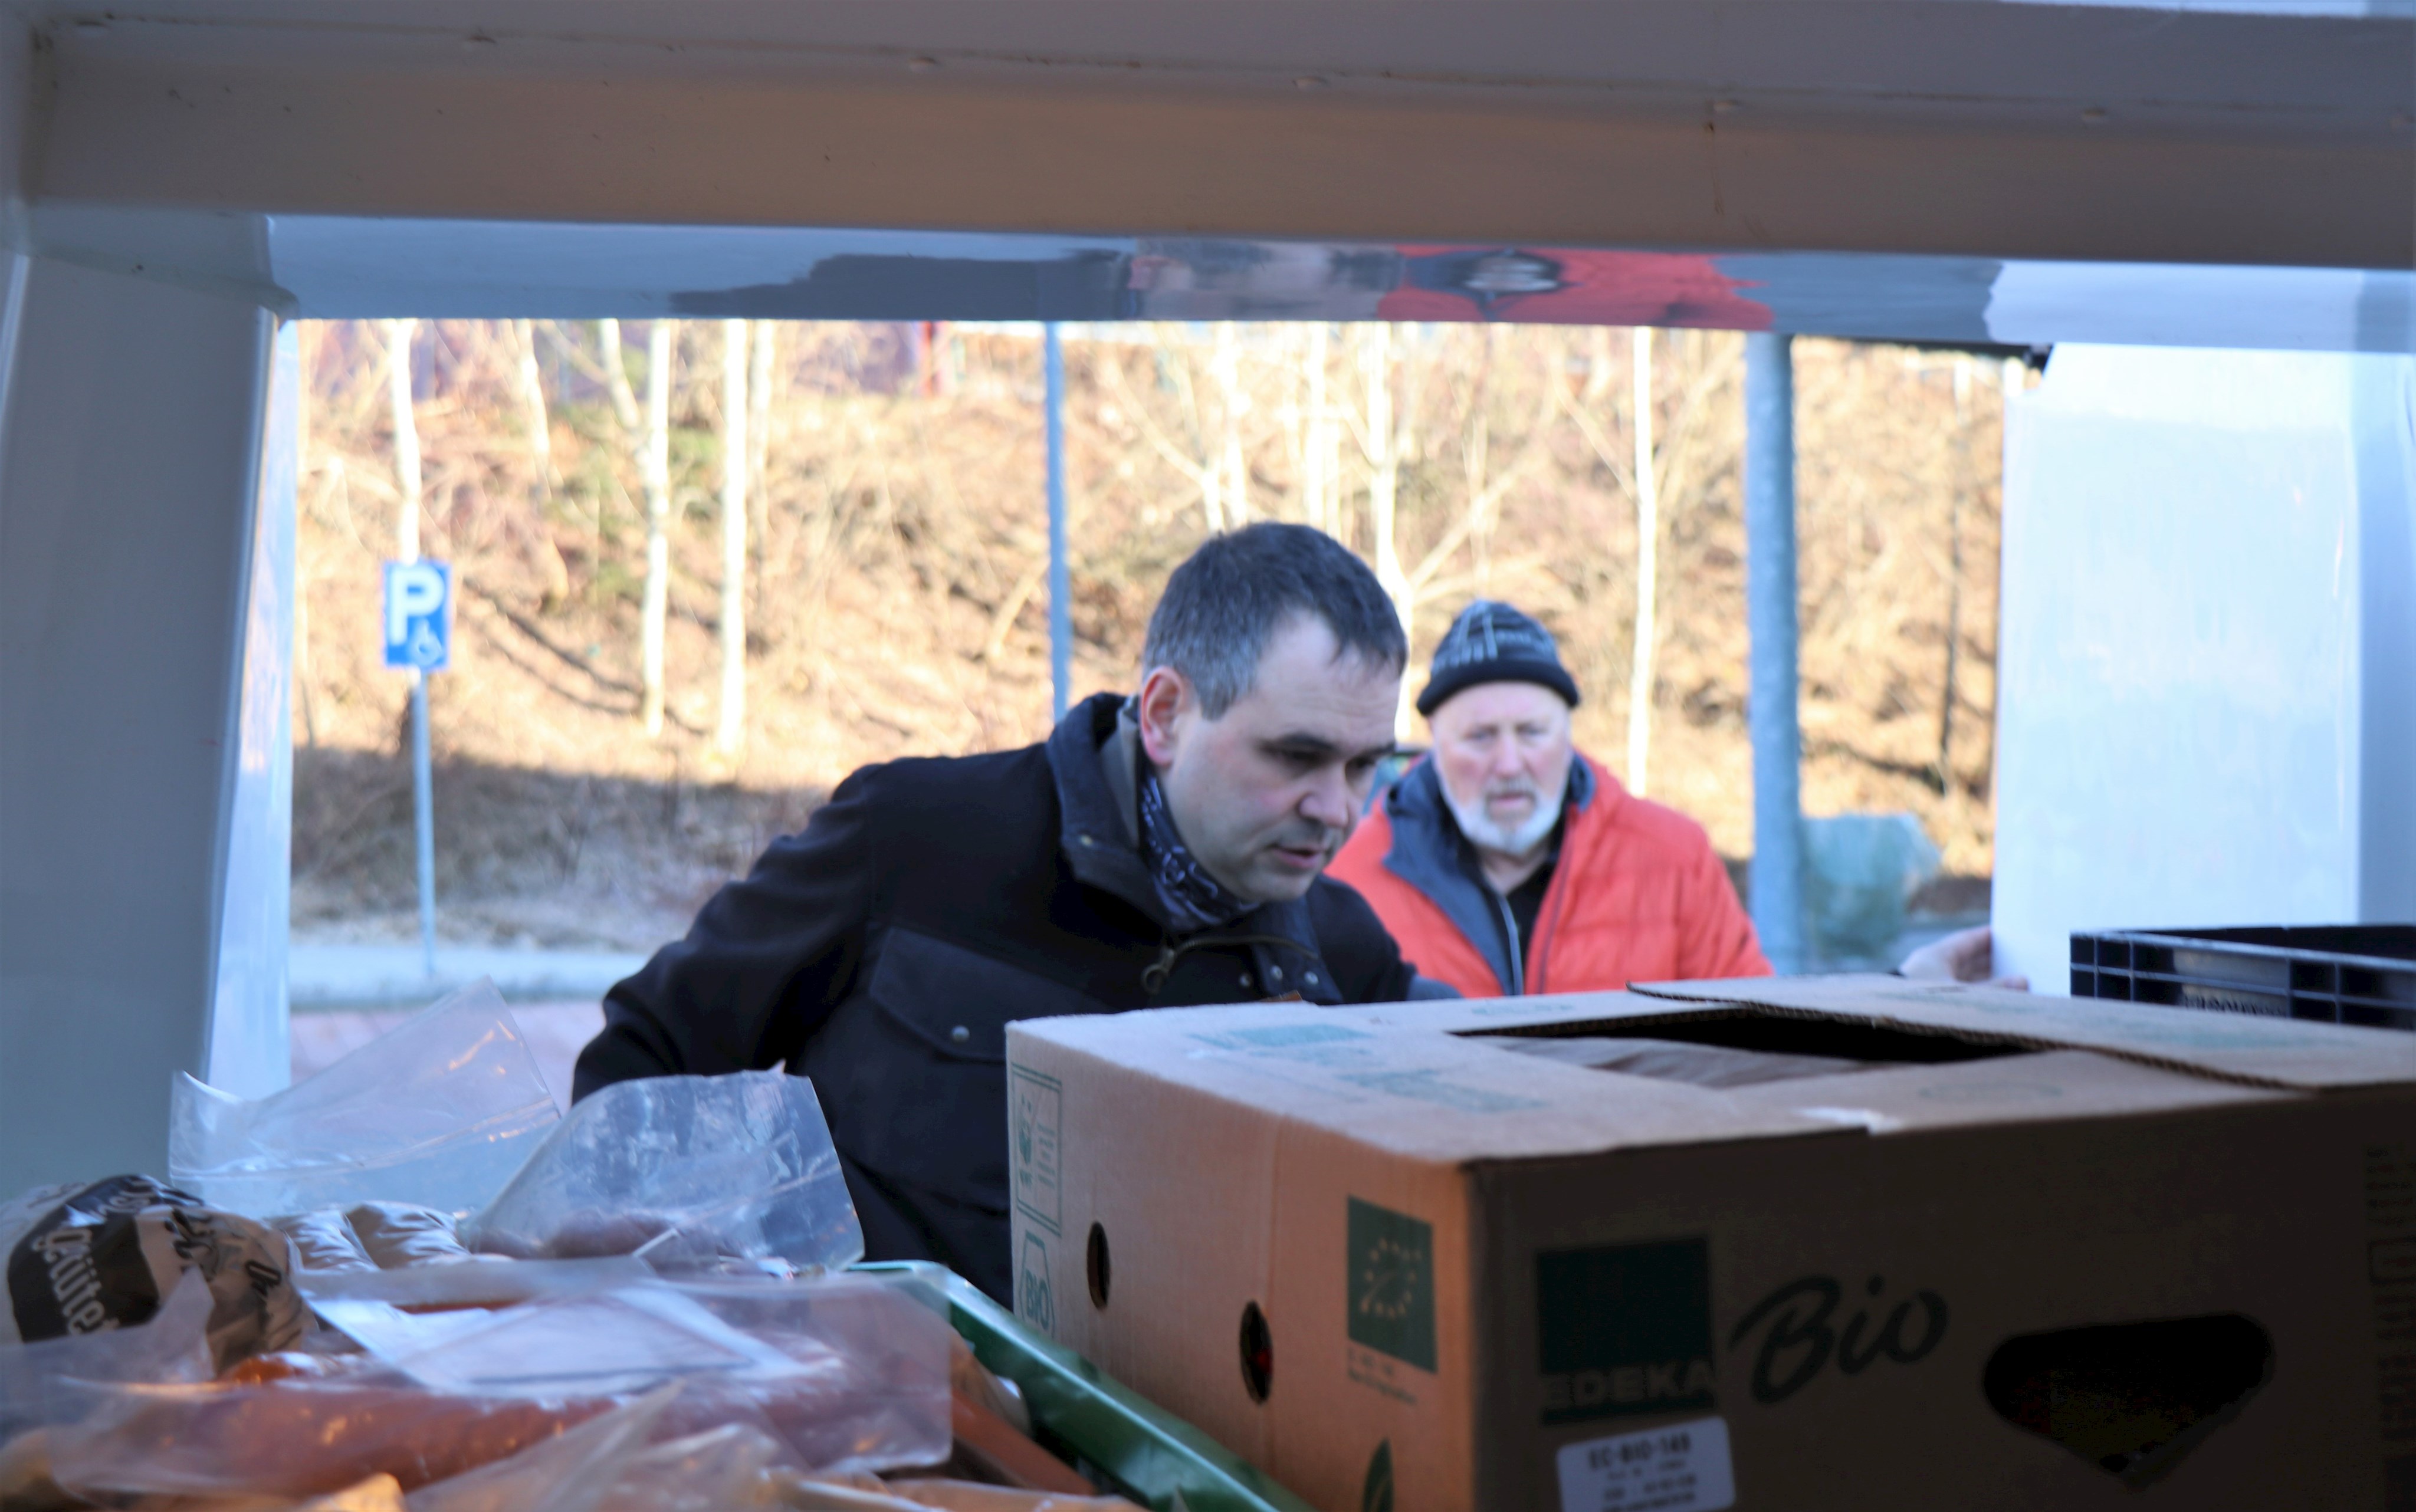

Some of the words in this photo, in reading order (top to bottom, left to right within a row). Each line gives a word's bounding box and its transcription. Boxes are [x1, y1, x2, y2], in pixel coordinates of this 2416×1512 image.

[389, 566, 445, 645] P
[1543, 1359, 1714, 1406] EDEKA
[1729, 1275, 1949, 1402] Bio
